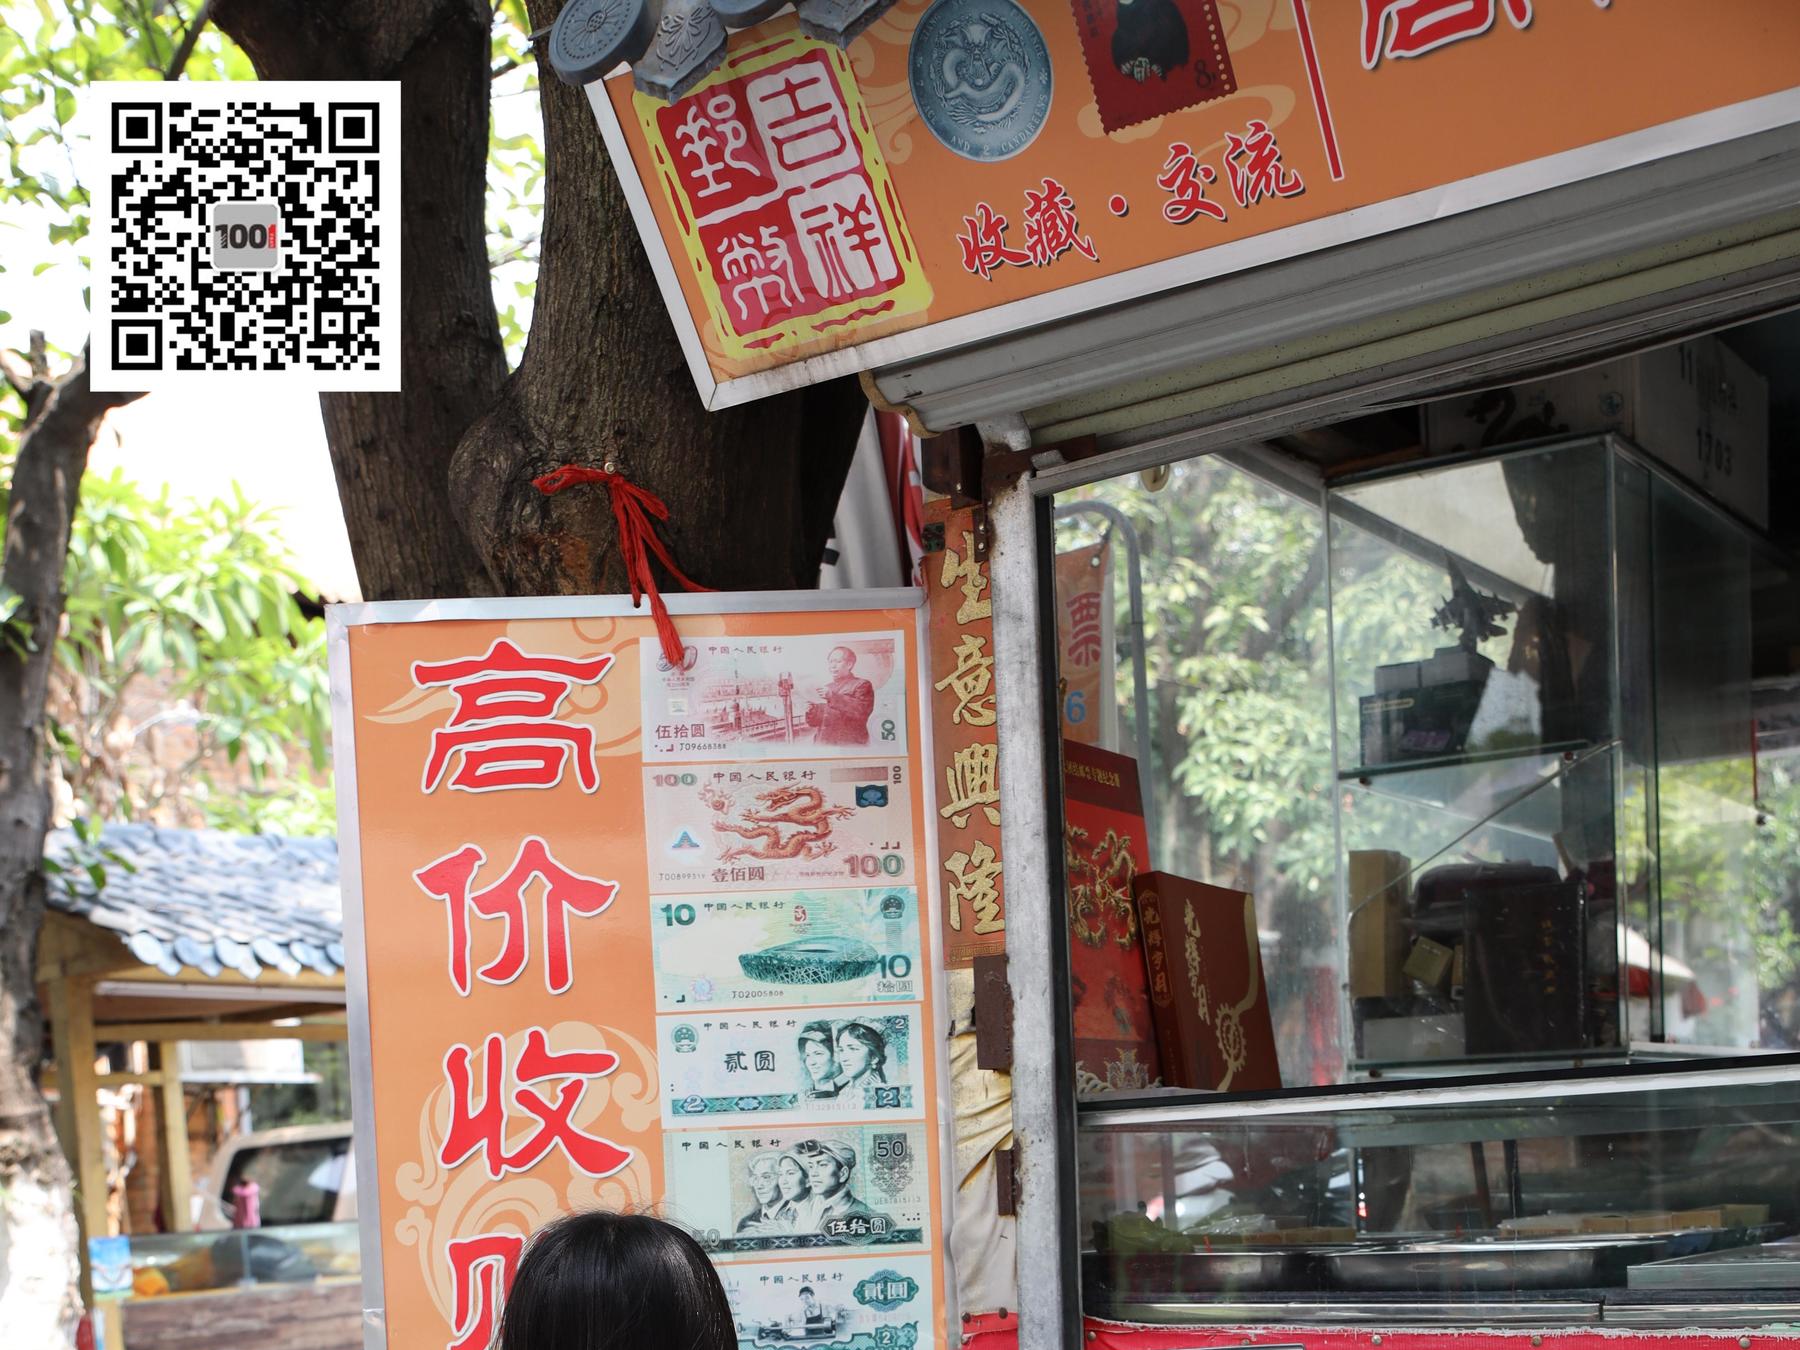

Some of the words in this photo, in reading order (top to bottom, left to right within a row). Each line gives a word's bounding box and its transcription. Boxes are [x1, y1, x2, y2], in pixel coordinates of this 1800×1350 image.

[881, 719, 896, 742] 50
[652, 773, 698, 787] 100
[712, 769, 817, 784] 中国人民银行
[893, 765, 902, 785] 100
[844, 853, 906, 877] 100
[704, 901, 786, 912] 中国人民银行
[660, 904, 697, 926] 10
[876, 954, 912, 979] 10
[703, 1019, 798, 1030] 中国人民银行
[895, 1018, 904, 1029] 2
[724, 1050, 776, 1072] 贰圆
[687, 1094, 698, 1110] 2
[882, 1091, 893, 1104] 2
[681, 1138, 783, 1150] 中国人民银行
[876, 1141, 905, 1158] 50
[828, 1219, 886, 1235] 伍拾圆
[882, 1332, 891, 1344] 2
